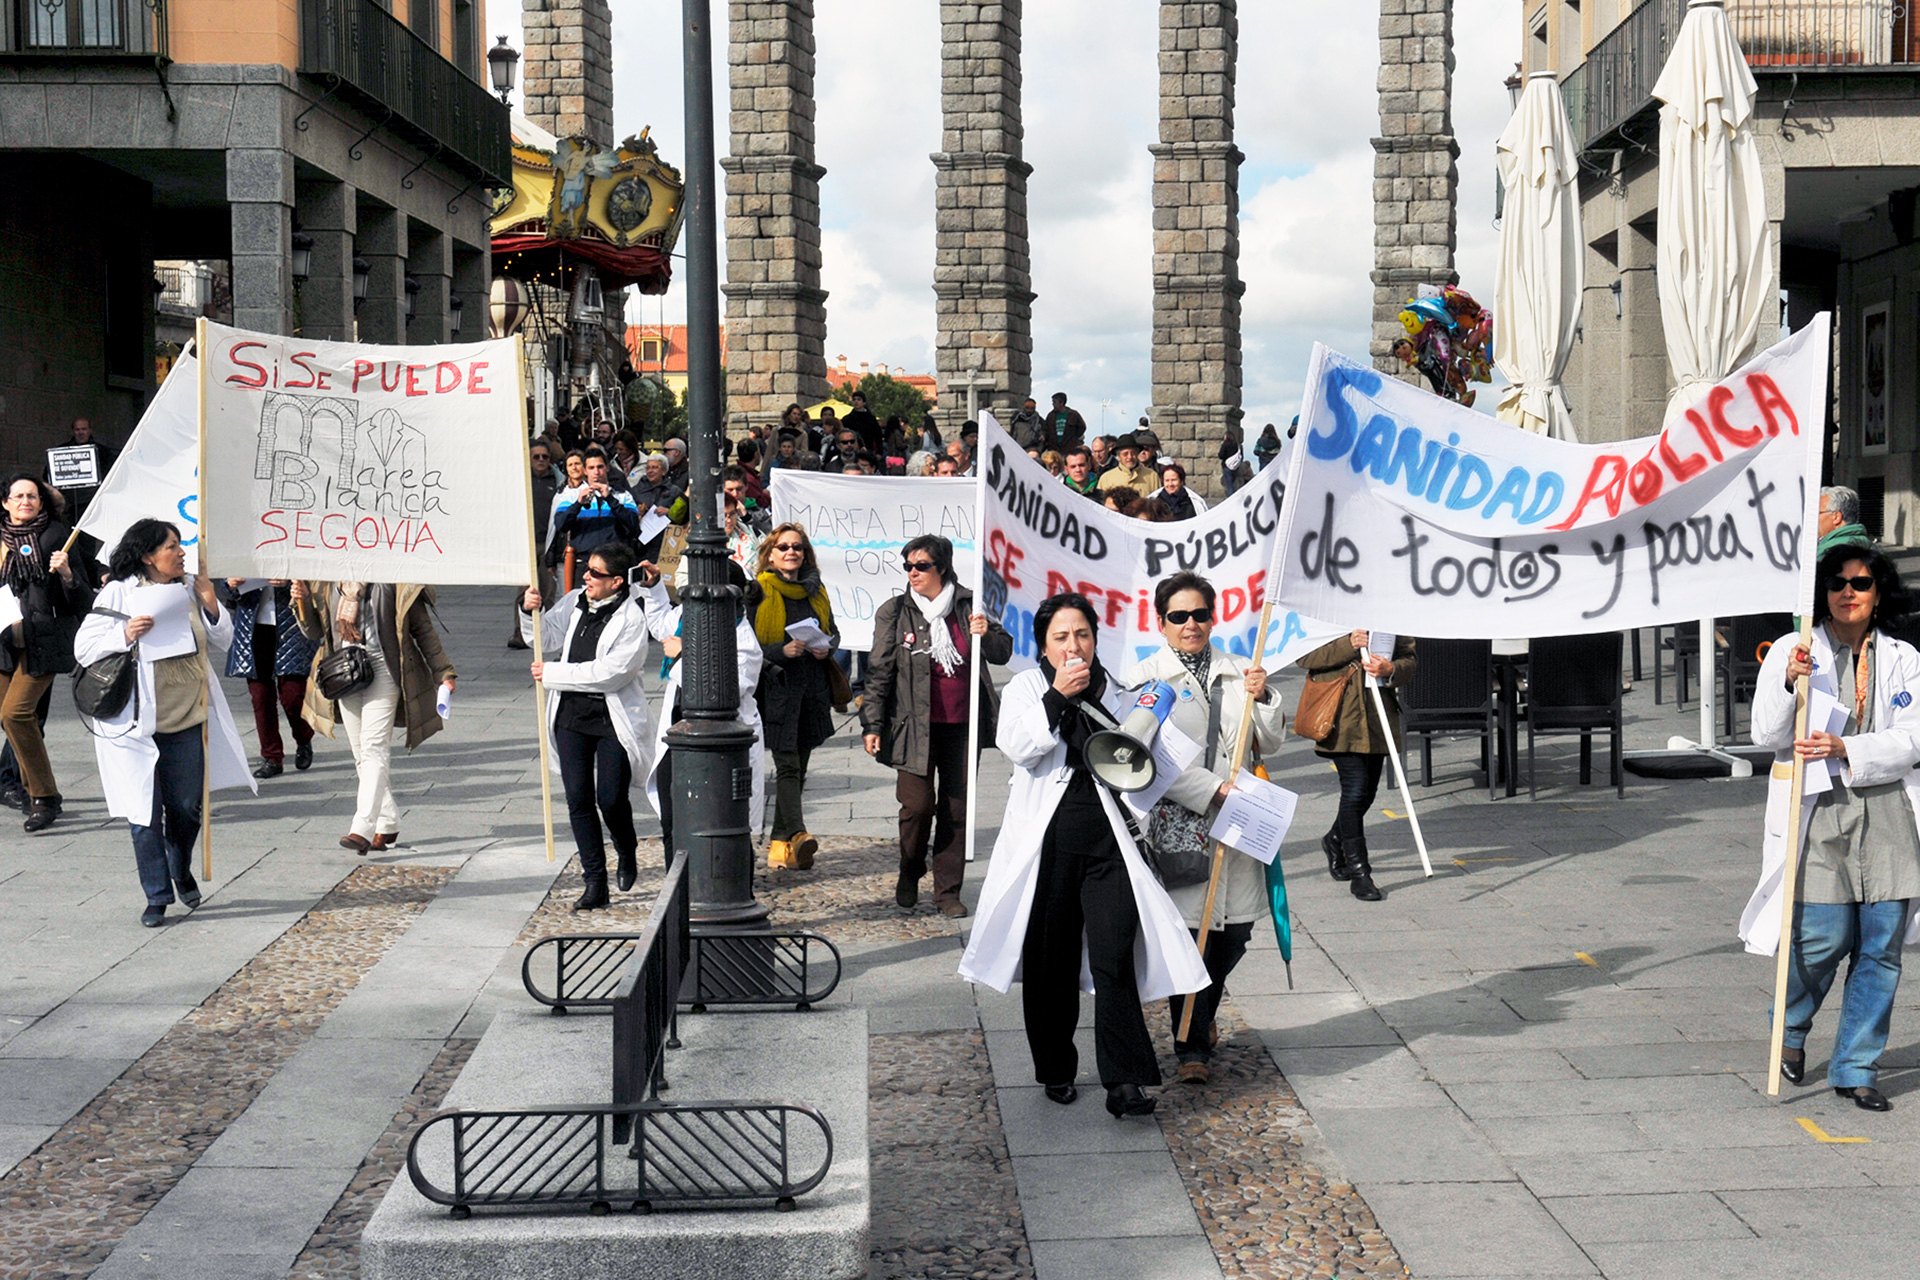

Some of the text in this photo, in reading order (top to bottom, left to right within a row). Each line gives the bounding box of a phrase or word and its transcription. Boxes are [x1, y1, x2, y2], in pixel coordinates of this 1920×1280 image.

[352, 360, 492, 397] PUEDE
[1307, 365, 1565, 525] SANIDAD
[269, 450, 450, 515] Blanca
[985, 443, 1286, 577] SANIDAD PÚBLICA
[256, 510, 443, 554] SEGOVIA
[789, 503, 975, 540] MAREA BLAN
[1300, 492, 1362, 594] de
[1581, 533, 1625, 620] y
[1643, 513, 1754, 606] para
[1746, 467, 1805, 572] tod
[844, 550, 902, 575] POR
[988, 529, 1025, 588] SE
